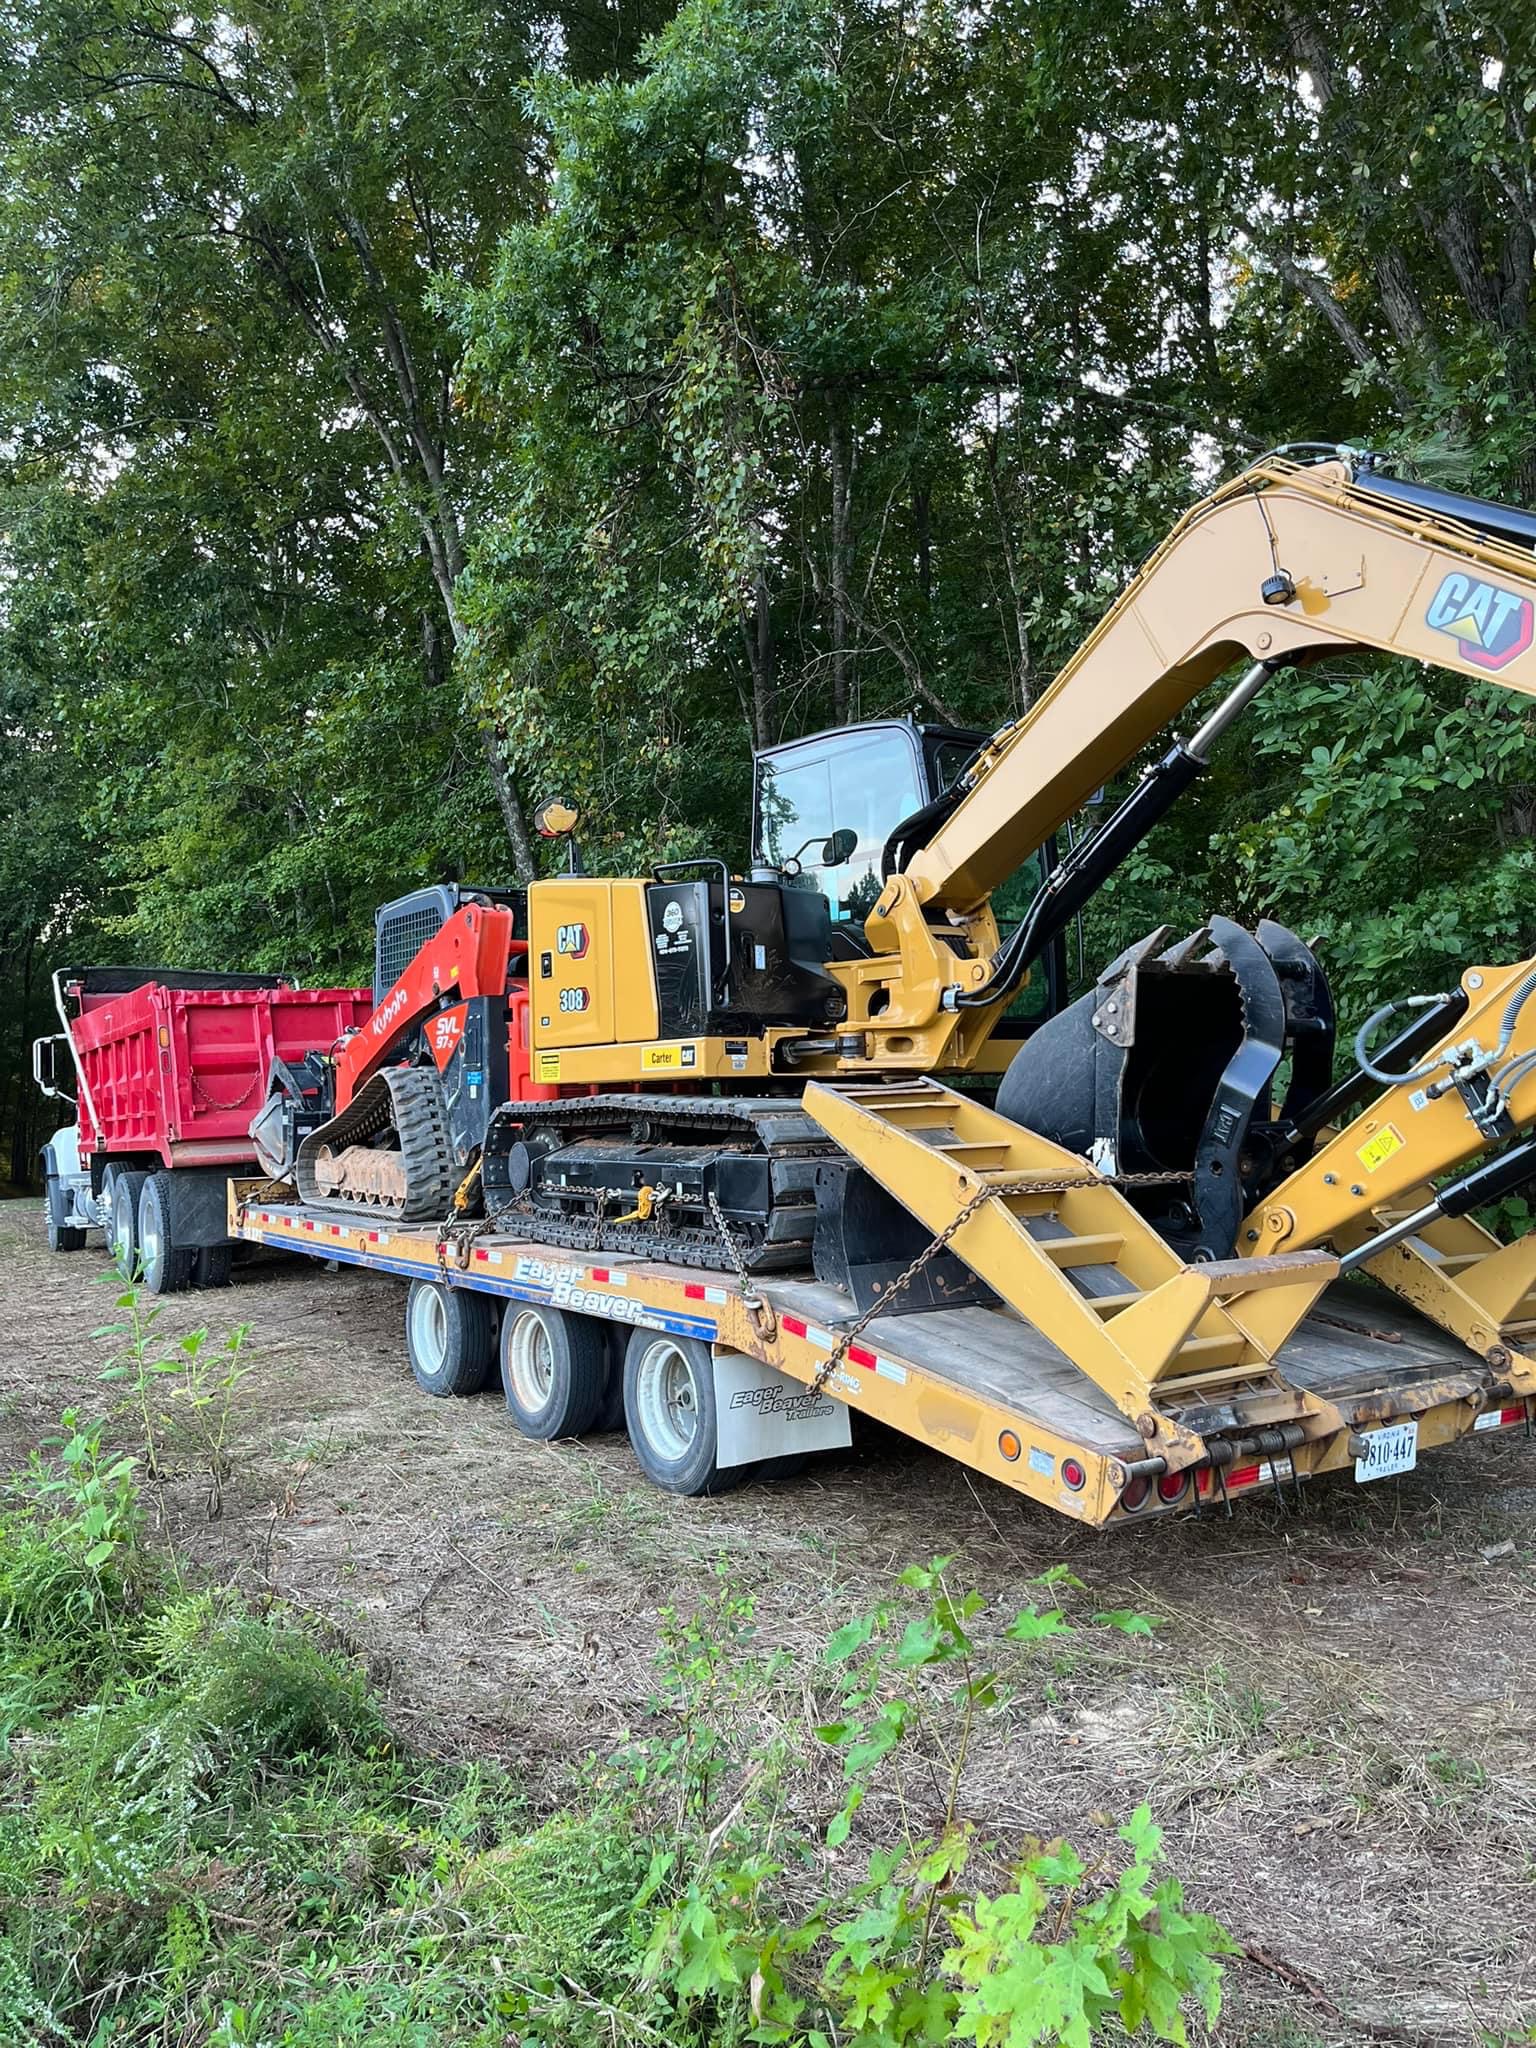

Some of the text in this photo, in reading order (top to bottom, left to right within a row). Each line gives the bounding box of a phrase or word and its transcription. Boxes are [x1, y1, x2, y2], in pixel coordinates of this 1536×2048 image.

[1427, 573, 1522, 649] CAT
[557, 925, 582, 953] CAT
[372, 988, 408, 1035] Kubota
[560, 987, 583, 1011] 308
[436, 1016, 460, 1035] SVL
[651, 1052, 672, 1064] Carter
[512, 1255, 586, 1289] Eager
[550, 1283, 644, 1320] Beaver
[730, 1385, 783, 1410] Eager
[759, 1392, 822, 1415] Beaver
[786, 1406, 834, 1421] Trailers
